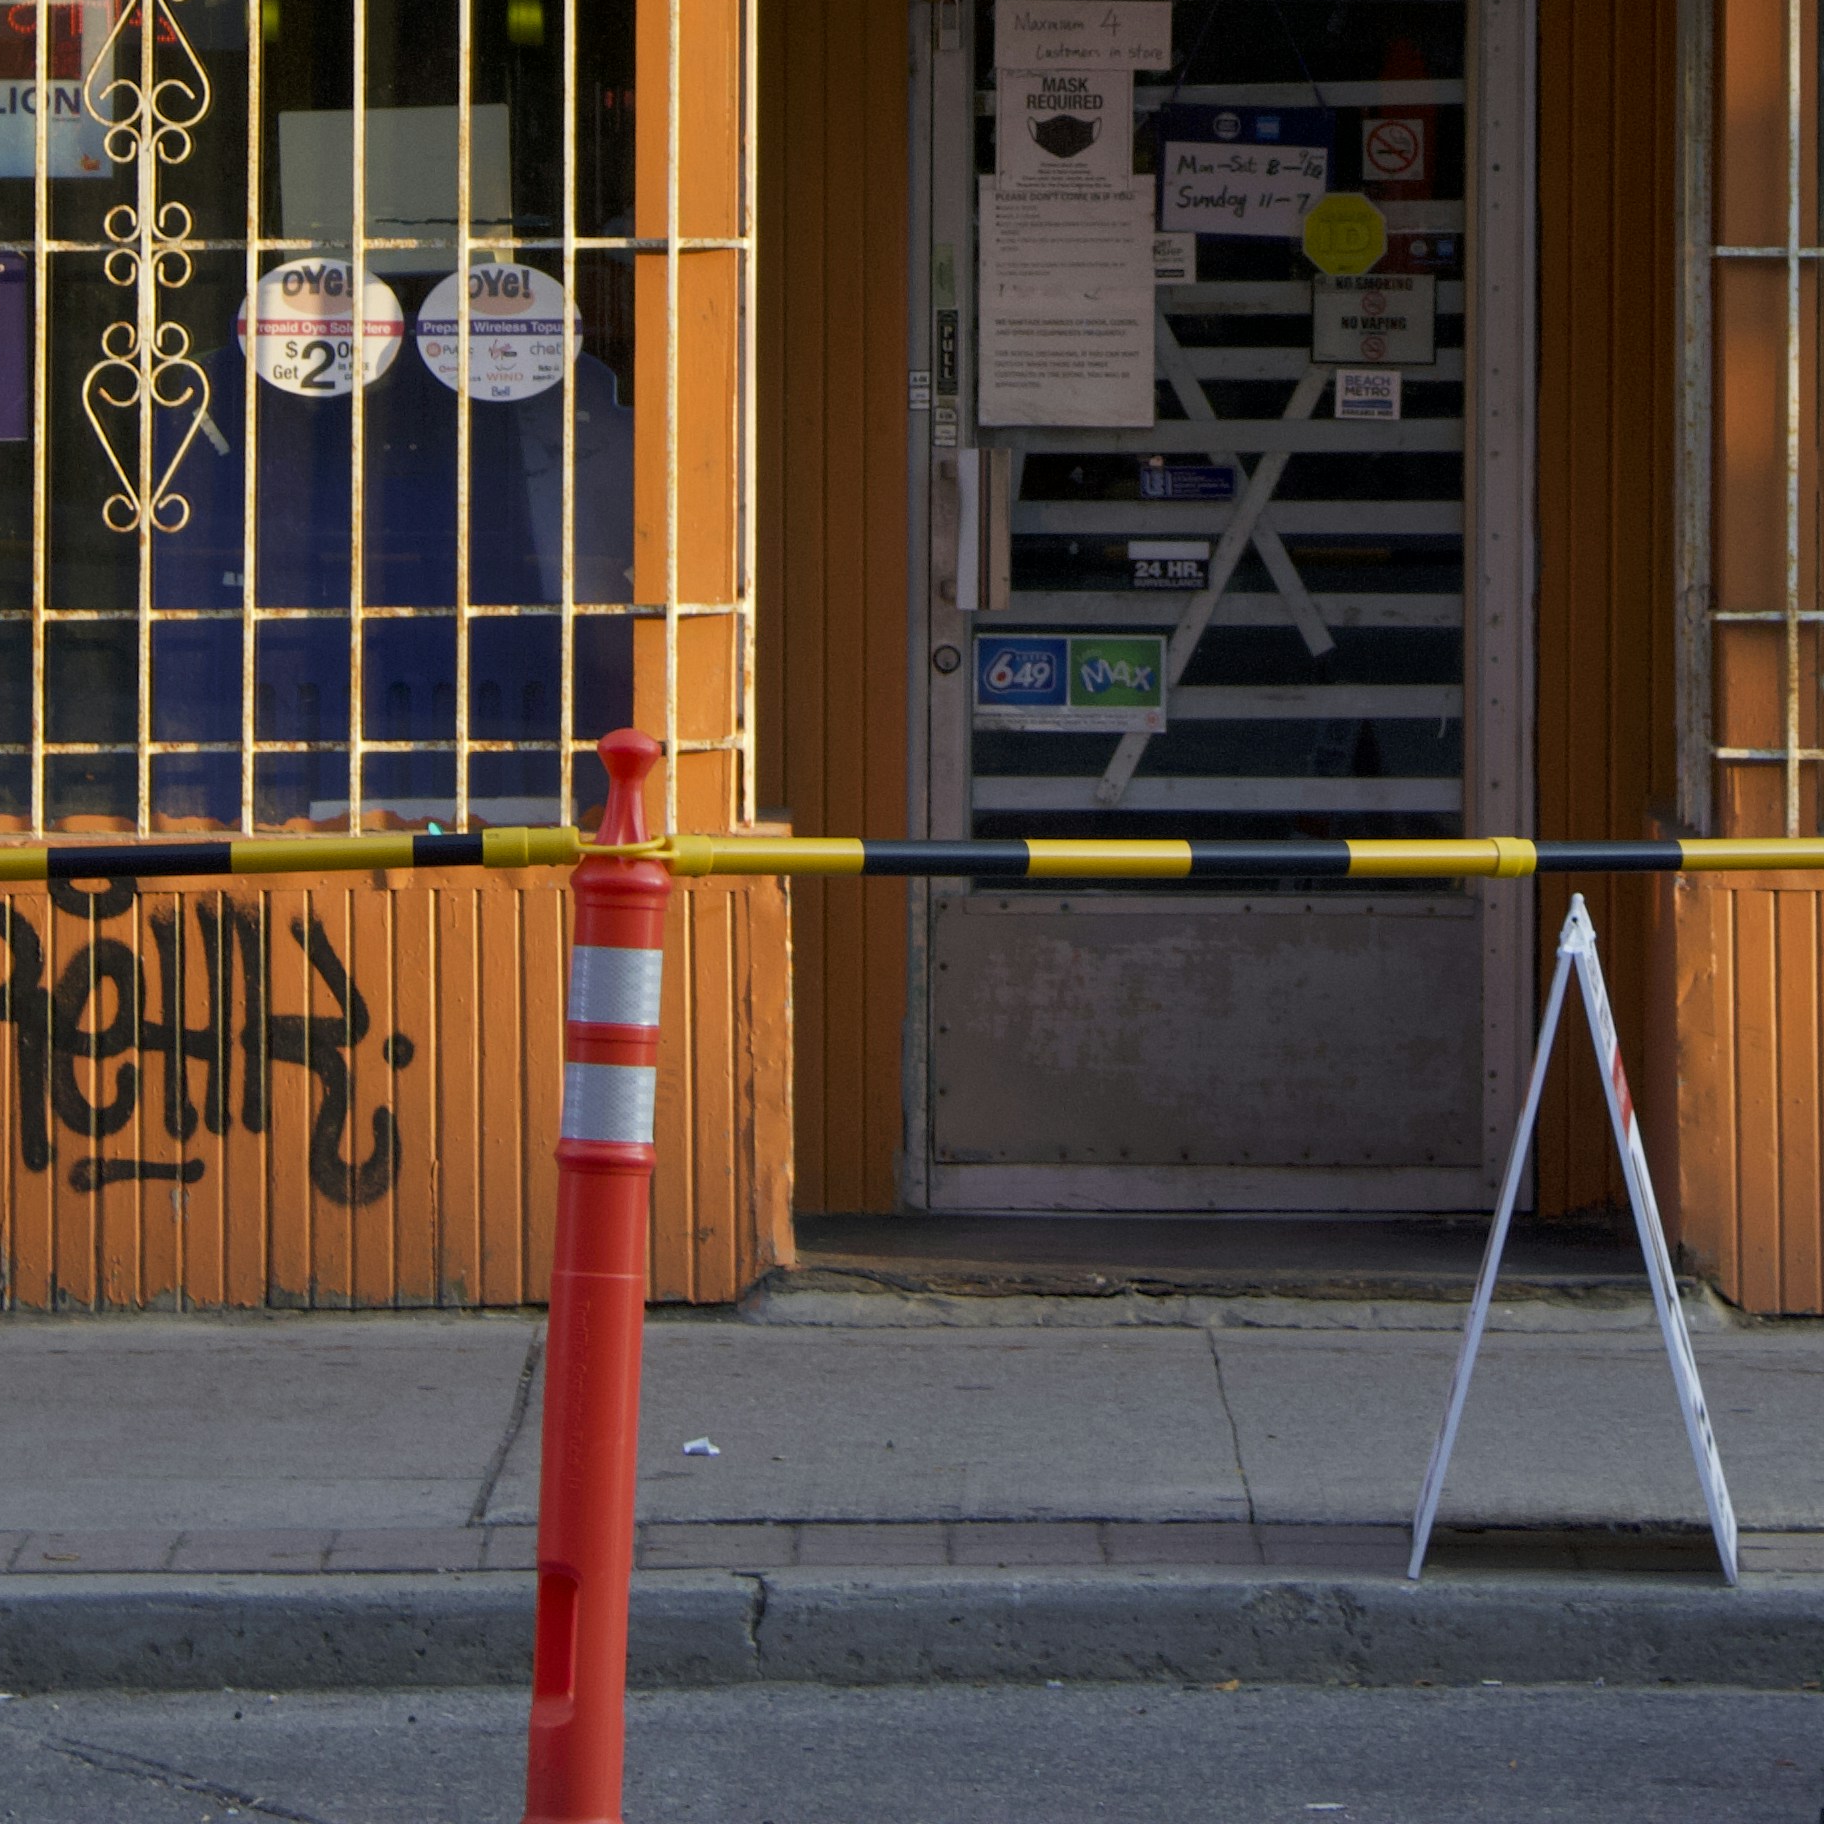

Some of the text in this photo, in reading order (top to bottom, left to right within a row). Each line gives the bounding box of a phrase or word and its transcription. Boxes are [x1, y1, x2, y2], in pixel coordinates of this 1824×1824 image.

[1099, 7, 1122, 36] 4
[1127, 42, 1164, 60] store
[1041, 77, 1089, 92] MASK
[1025, 94, 1104, 110] REQUIRED
[1176, 184, 1247, 218] Sunday
[301, 321, 327, 337] Oye
[473, 321, 528, 334] Wireless
[1341, 316, 1407, 329] NO VAPING
[942, 325, 955, 378] PULL
[272, 364, 299, 380] Get
[1344, 375, 1391, 386] BEACH
[1345, 386, 1391, 397] METRO
[1135, 559, 1204, 578] 24 HR.
[989, 651, 1052, 690] 649
[1079, 658, 1153, 694] MAX
